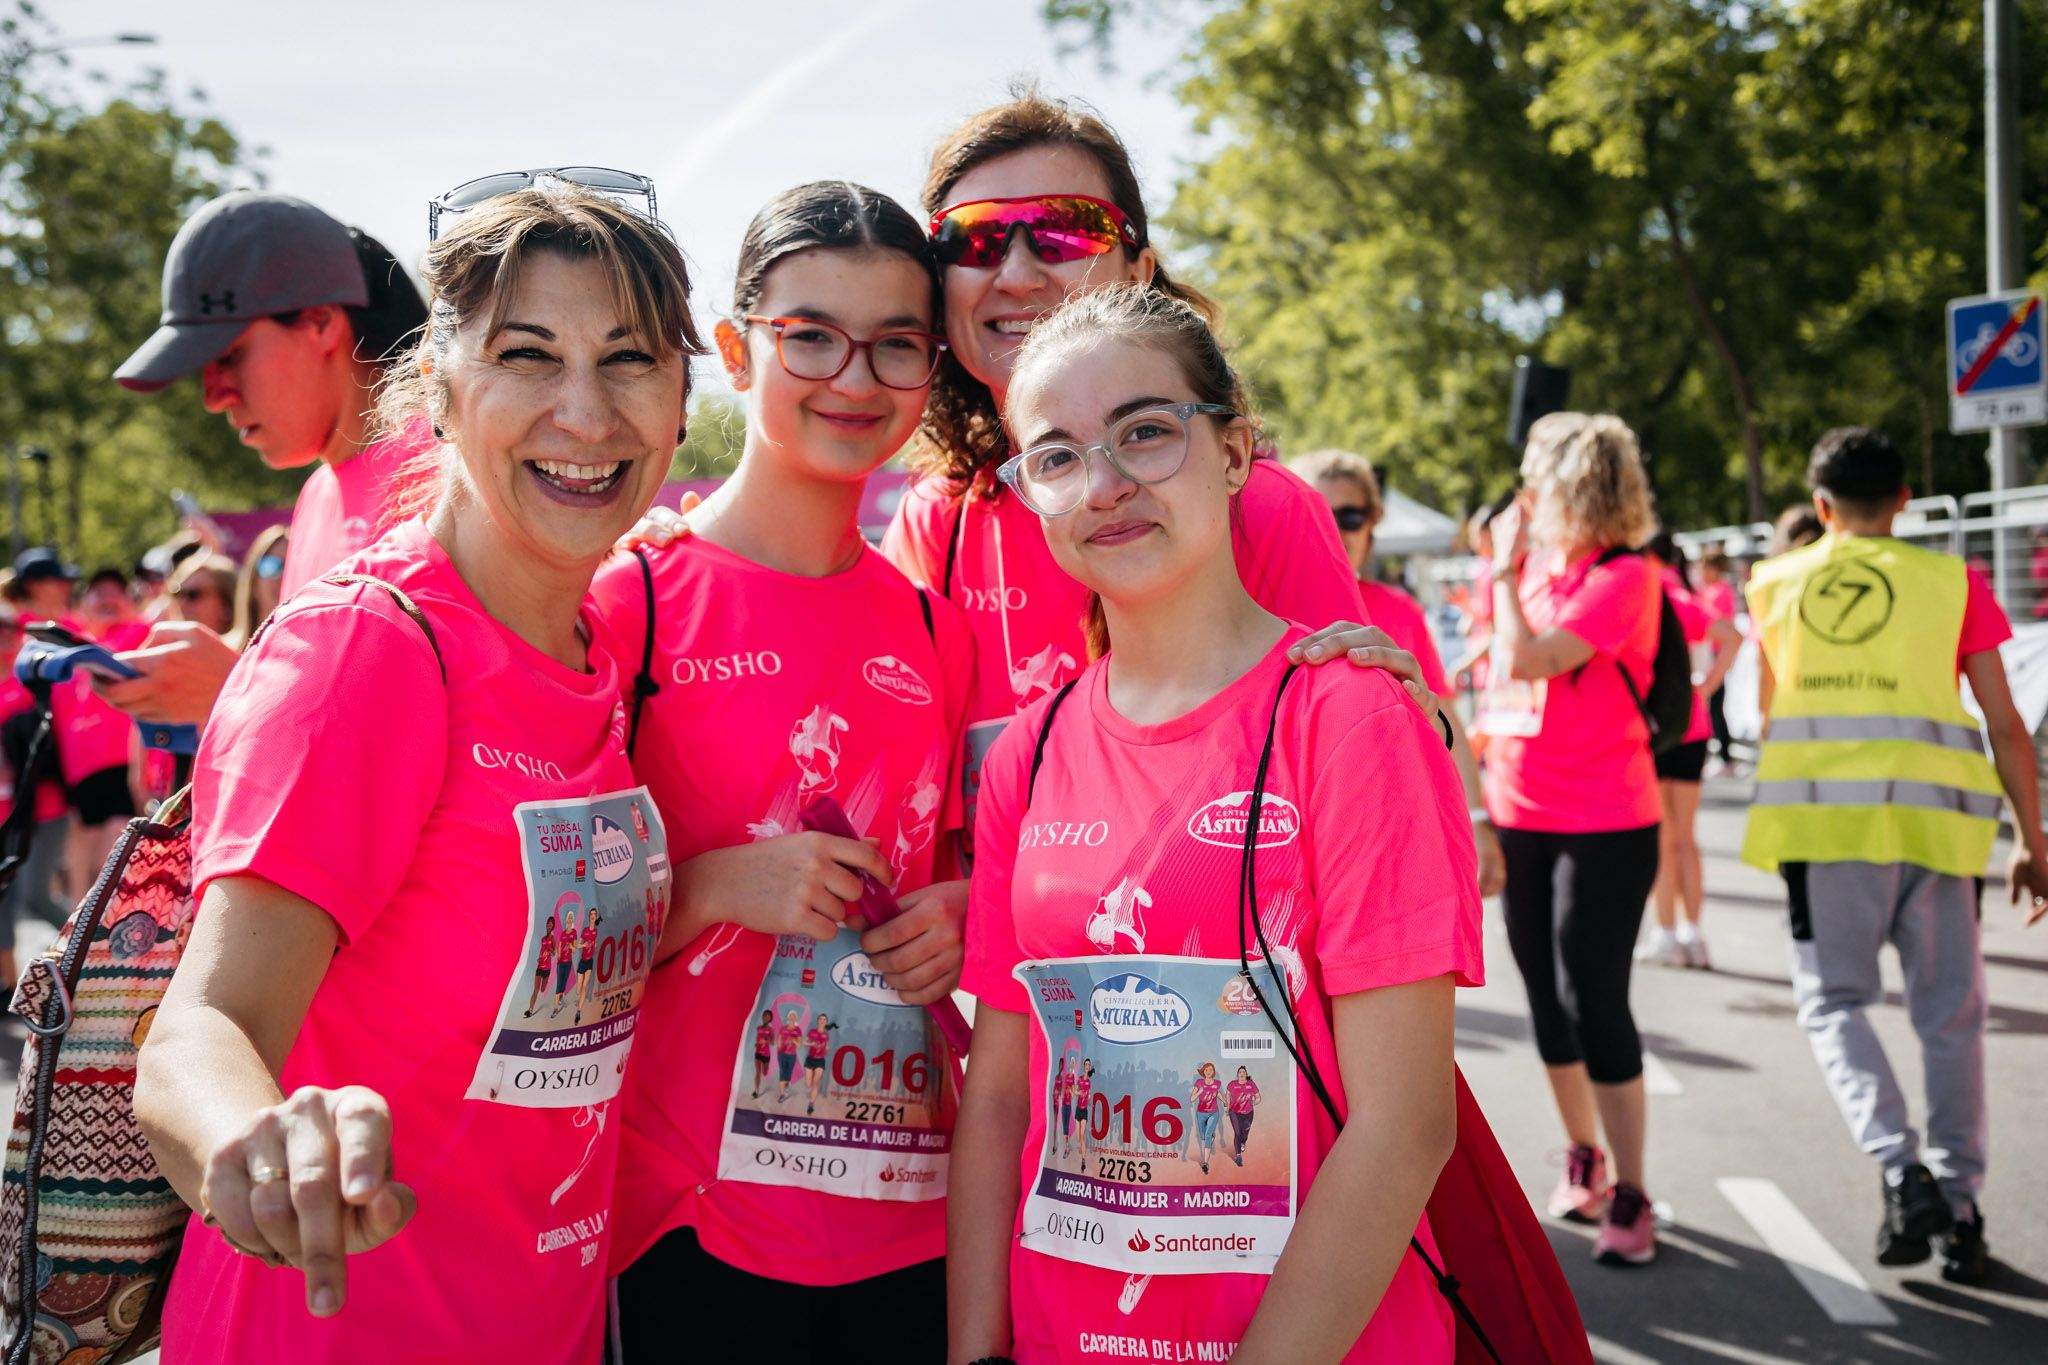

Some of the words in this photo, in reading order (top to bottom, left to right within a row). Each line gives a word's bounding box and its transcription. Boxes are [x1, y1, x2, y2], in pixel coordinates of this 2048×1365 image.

[961, 586, 1027, 612] OYSO
[672, 650, 781, 685] OYSHO
[537, 825, 549, 835] TU
[551, 822, 583, 834] DORSAL
[1018, 821, 1109, 852] OYSHO
[1196, 813, 1295, 834] ASTUIANA
[540, 835, 583, 853] SUMA
[592, 843, 633, 870] STURIANA
[549, 867, 573, 877] MADRID
[596, 924, 645, 984] 016
[601, 989, 632, 1019] 22762
[1041, 987, 1077, 1002] SUMA
[531, 1032, 587, 1052] CARRERA
[590, 1028, 603, 1045] DE
[603, 1025, 612, 1041] LA
[613, 1015, 635, 1037] MUJER
[515, 1064, 599, 1090] OYSHO
[831, 1045, 929, 1094] 016
[845, 1101, 904, 1124] 22761
[1090, 1092, 1184, 1147] 016
[764, 1119, 825, 1140] CARRERA
[830, 1125, 848, 1141] DE
[851, 1127, 868, 1142] LA
[872, 1130, 912, 1147] MUJER
[755, 1148, 847, 1179] OYSHO
[1099, 1157, 1152, 1183] 22763
[1056, 1177, 1092, 1199] ARRERA
[1104, 1188, 1116, 1205] LA
[1119, 1190, 1169, 1209] MUJER
[1184, 1190, 1251, 1209] MADRID
[537, 1226, 579, 1253] CARRERA
[572, 1219, 592, 1240] DE
[588, 1213, 604, 1235] LA
[1047, 1212, 1105, 1245] OYSHO
[1154, 1233, 1257, 1252] Santander
[1080, 1332, 1149, 1358] CARRERA
[1152, 1339, 1173, 1360] DE
[1176, 1340, 1194, 1362] LA
[1197, 1341, 1239, 1362] MUJ
